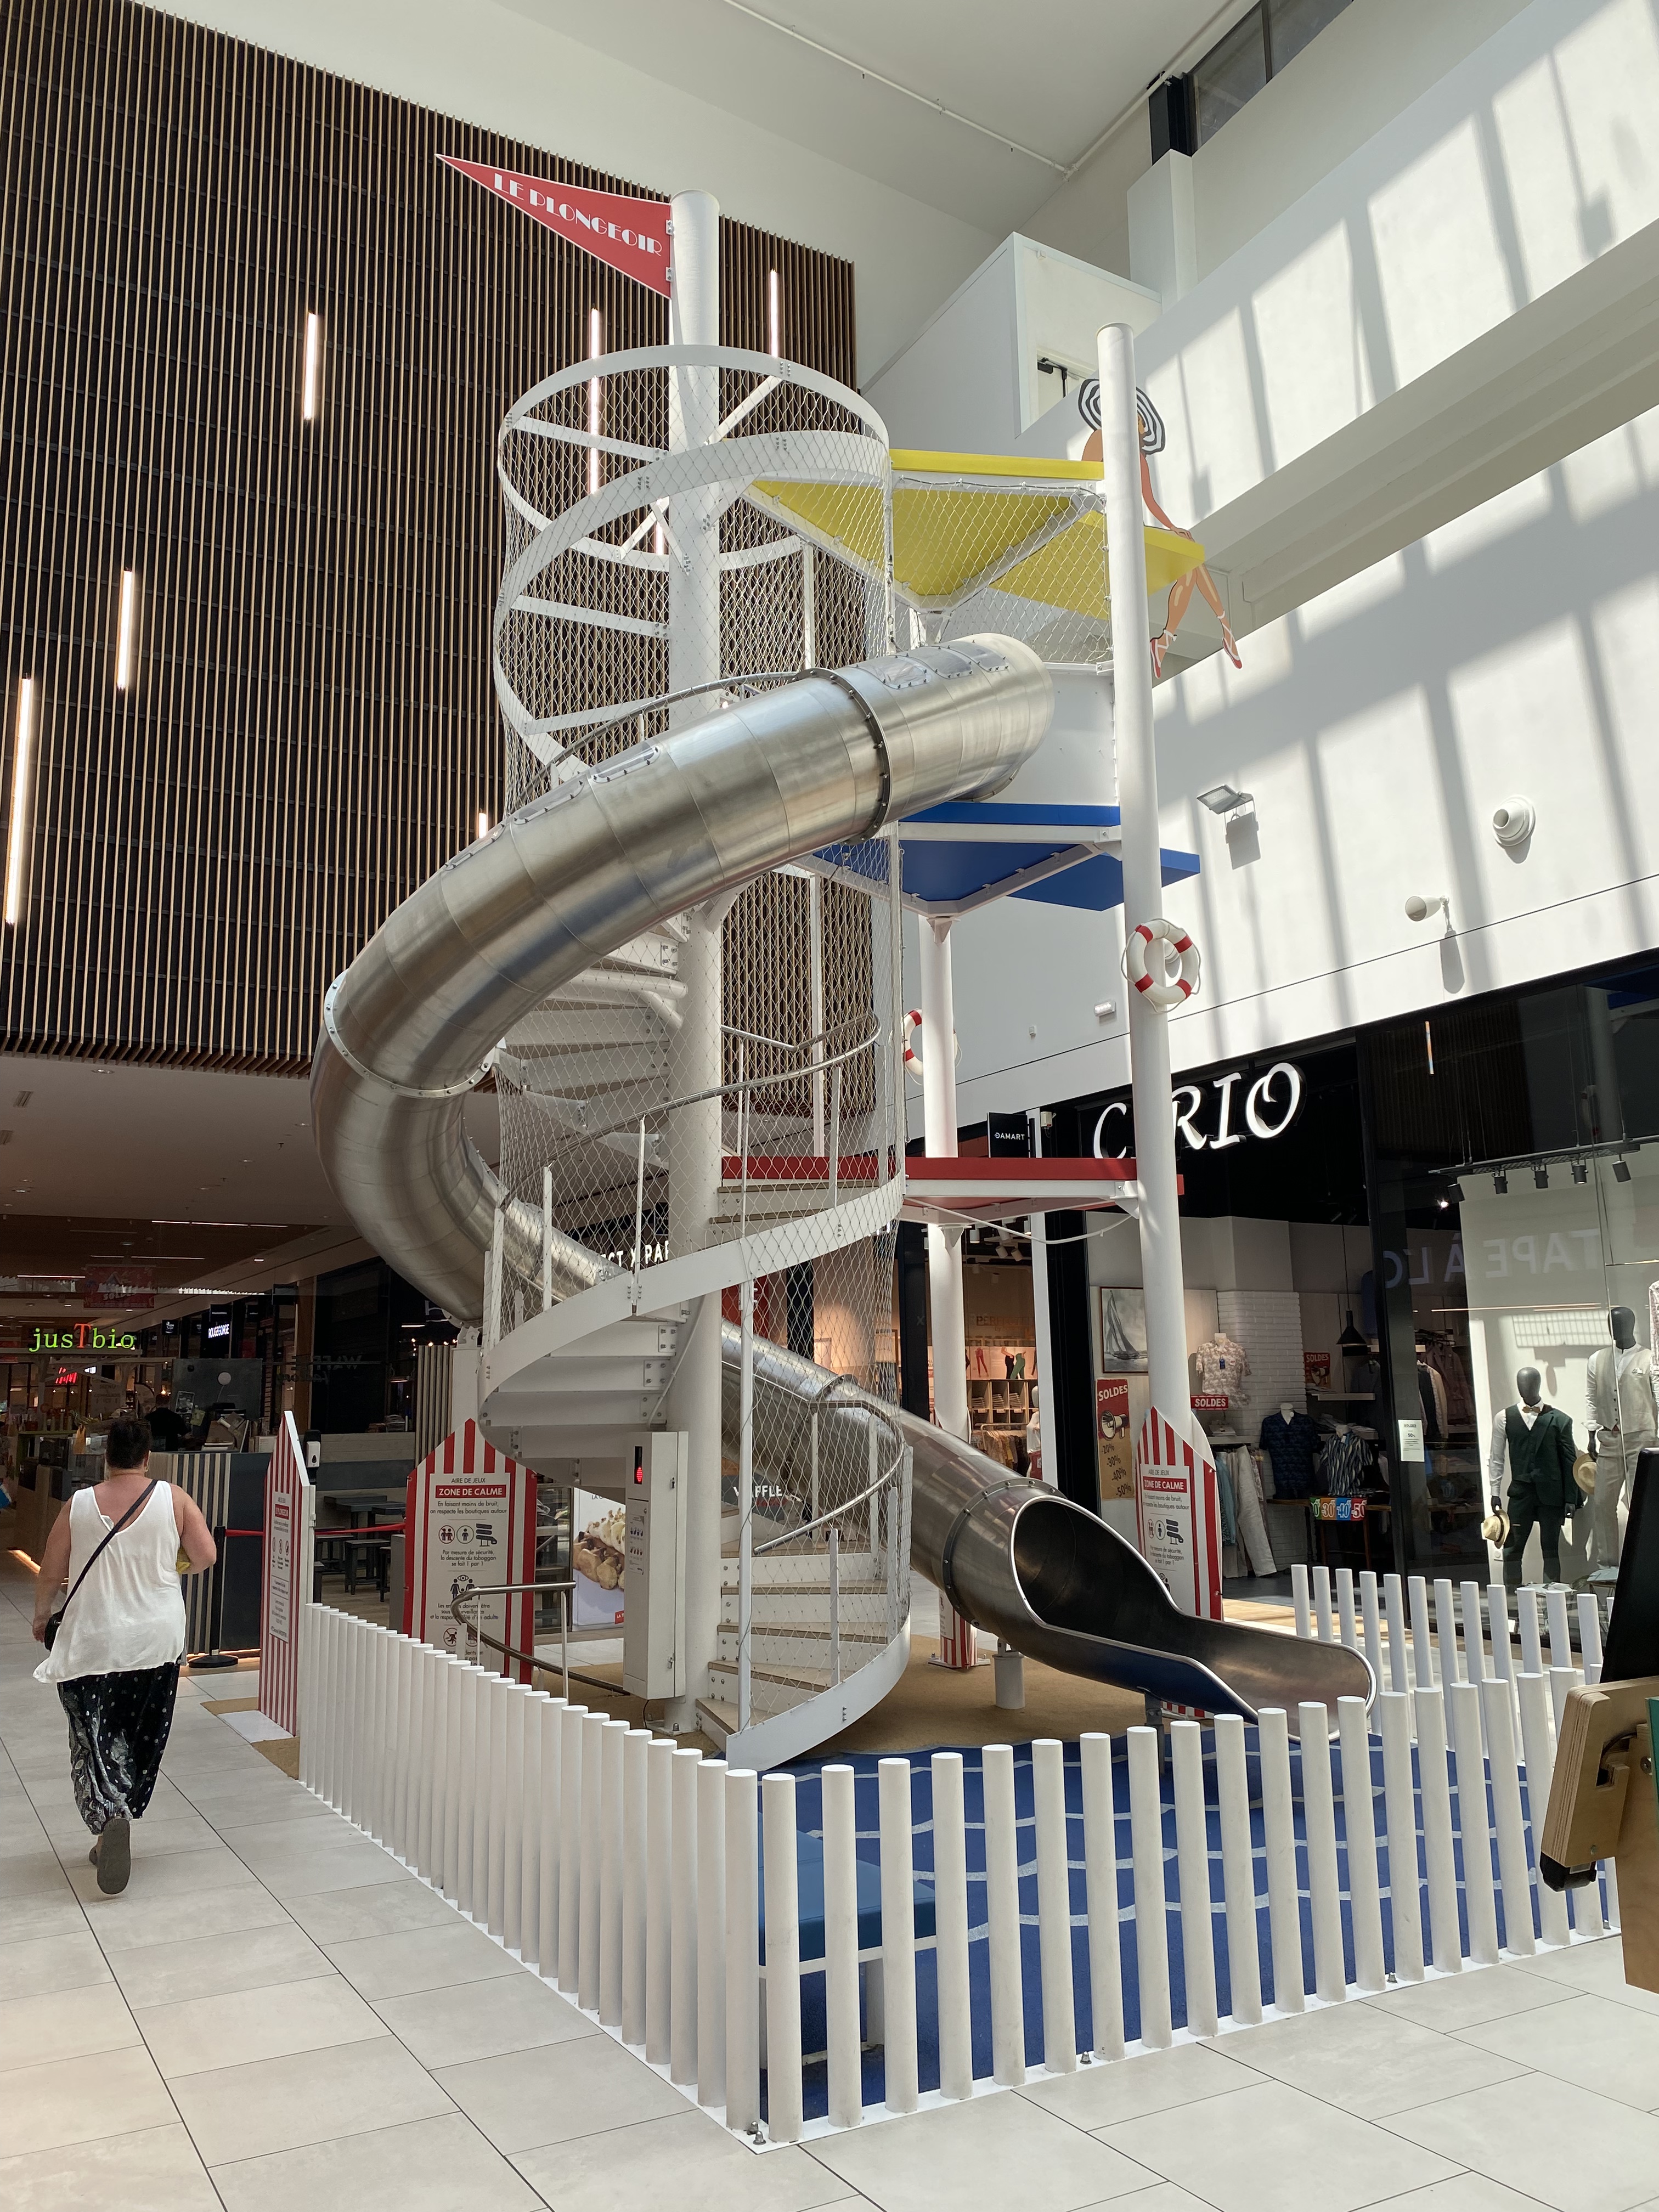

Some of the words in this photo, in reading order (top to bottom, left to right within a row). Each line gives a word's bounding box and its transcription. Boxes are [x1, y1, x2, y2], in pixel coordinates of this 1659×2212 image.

[494, 172, 524, 201] LE
[529, 189, 663, 257] PLONGEOIR
[1093, 1062, 1302, 1160] CRIO
[995, 1131, 1025, 1141] DAMART
[103, 1293, 137, 1301] SOLDE
[29, 1323, 134, 1352] jusTbio
[1306, 1353, 1329, 1363] SOLDES
[1098, 1385, 1128, 1402] SOLDES
[1195, 1398, 1226, 1407] SOLDES
[1102, 1443, 1115, 1454] -20%
[1107, 1455, 1121, 1468] -30%
[1111, 1468, 1126, 1481] -40%
[1115, 1482, 1132, 1497] -50%
[1144, 1480, 1154, 1488] ZONE
[1162, 1481, 1184, 1489] CALME
